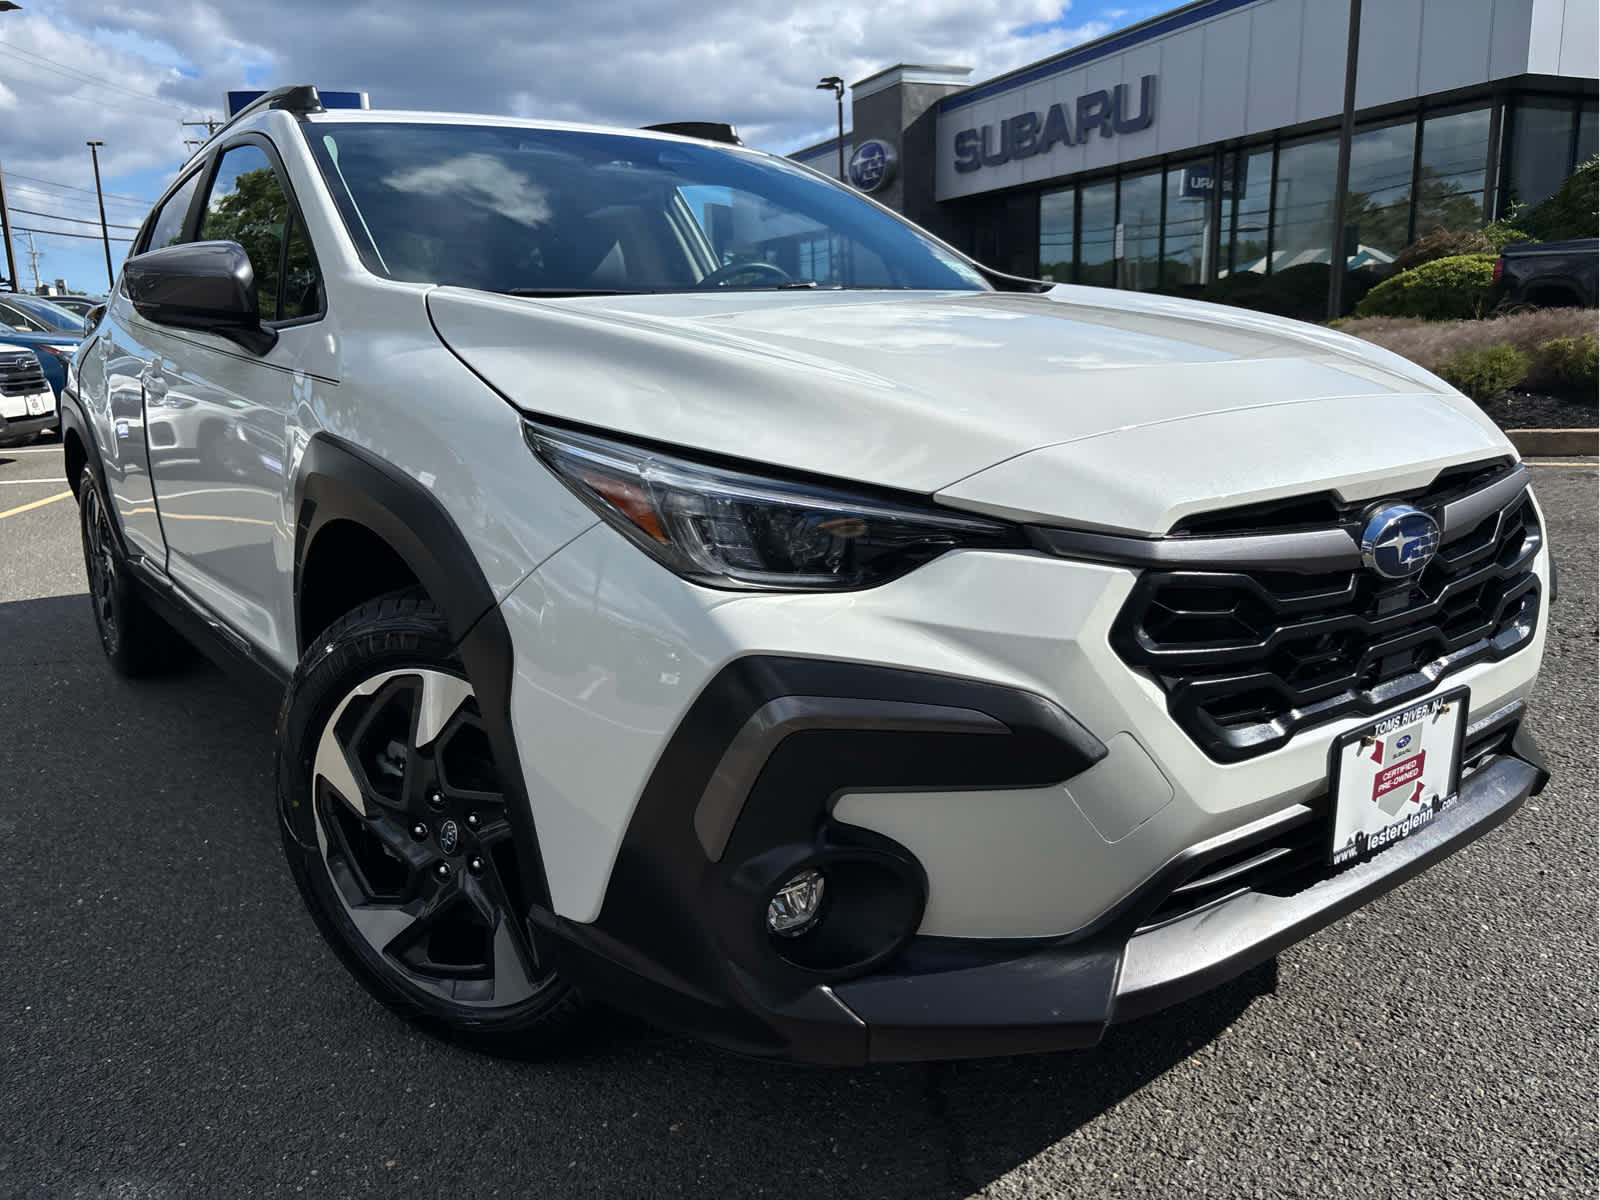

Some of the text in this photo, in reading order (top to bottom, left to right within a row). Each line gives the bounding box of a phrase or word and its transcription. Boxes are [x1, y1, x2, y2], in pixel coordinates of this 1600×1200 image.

[953, 74, 1156, 174] SUBARU
[1375, 715, 1401, 736] TOMS
[1432, 697, 1444, 713] NJ
[1378, 768, 1419, 792] PRE-OWNED
[1383, 760, 1417, 781] CERTIFIED
